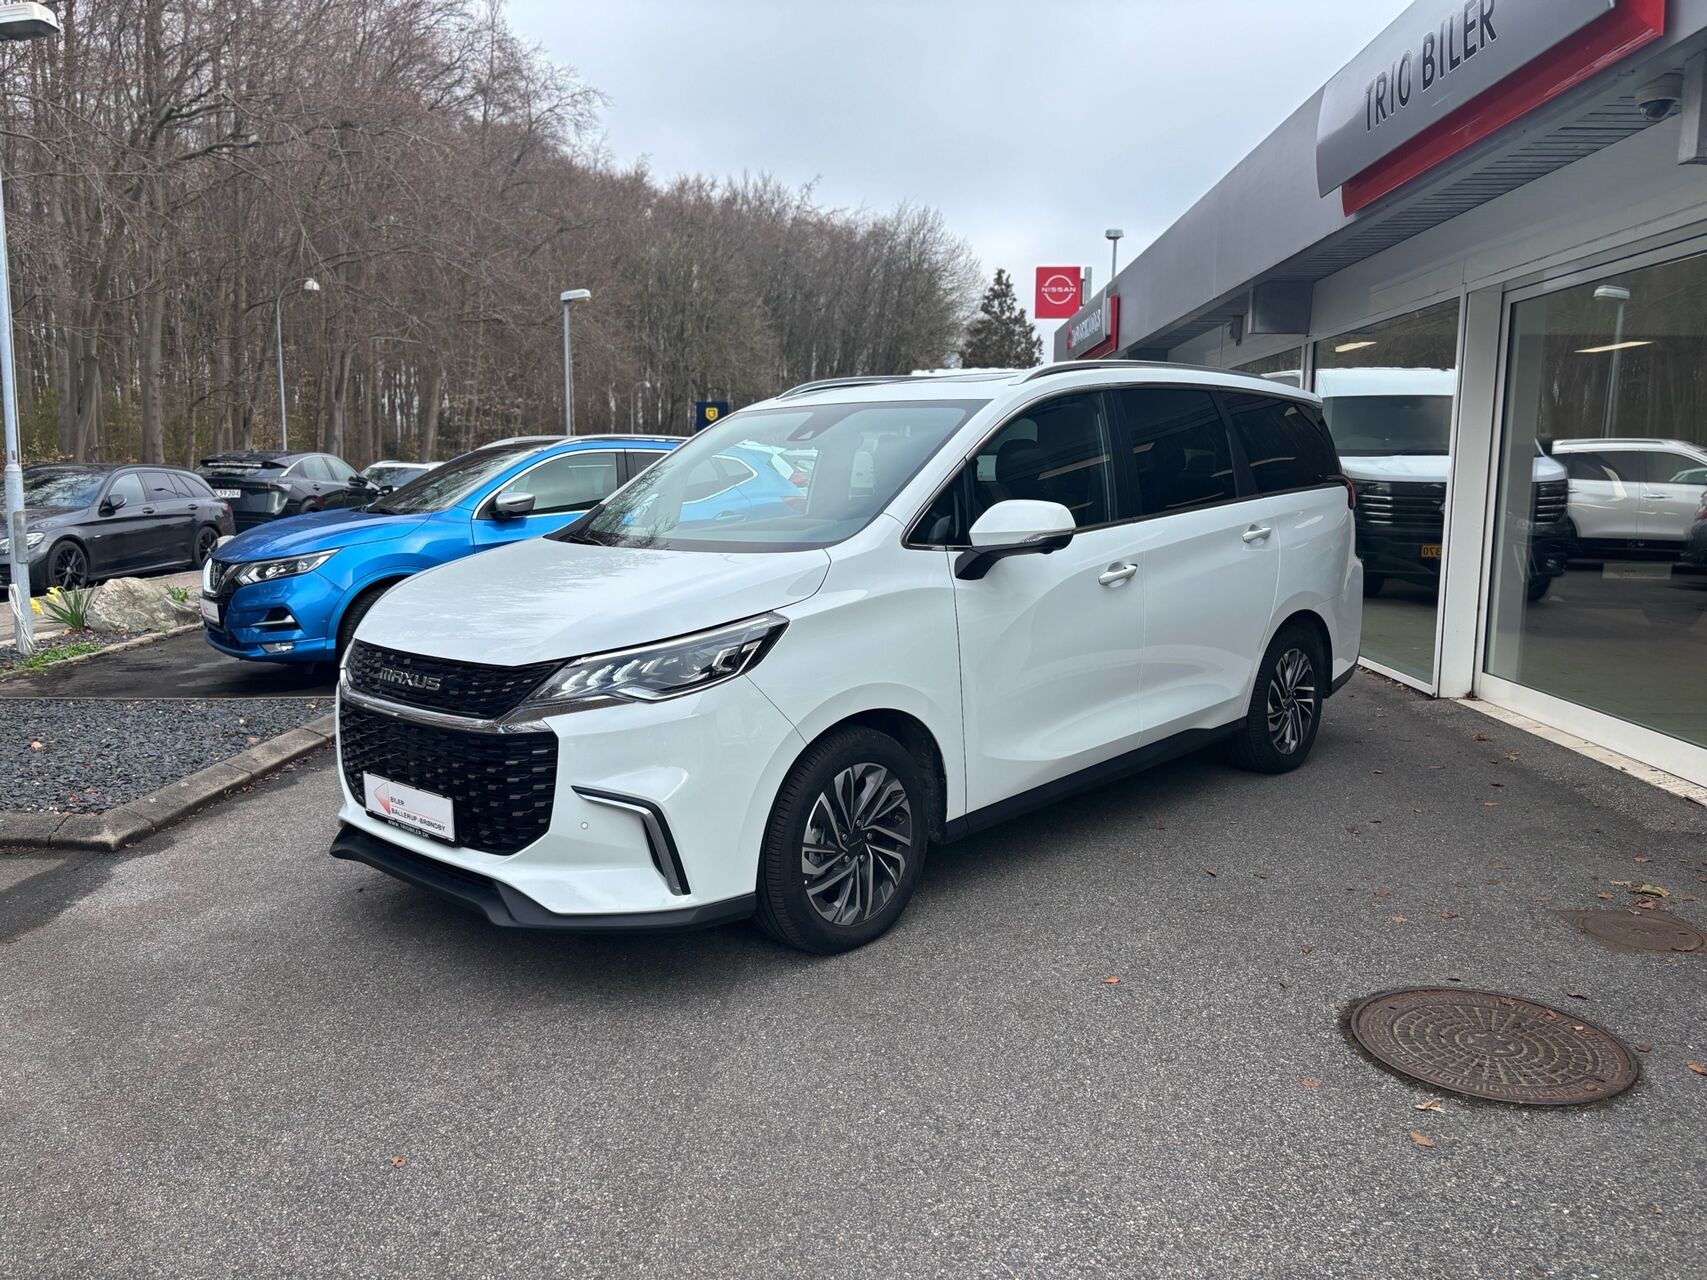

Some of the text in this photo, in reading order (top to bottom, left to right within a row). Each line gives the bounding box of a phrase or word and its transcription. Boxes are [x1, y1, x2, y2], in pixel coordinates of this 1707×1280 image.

[1365, 0, 1498, 132] TRIO BILER
[380, 667, 441, 691] MAXUS
[390, 796, 405, 805] BILER
